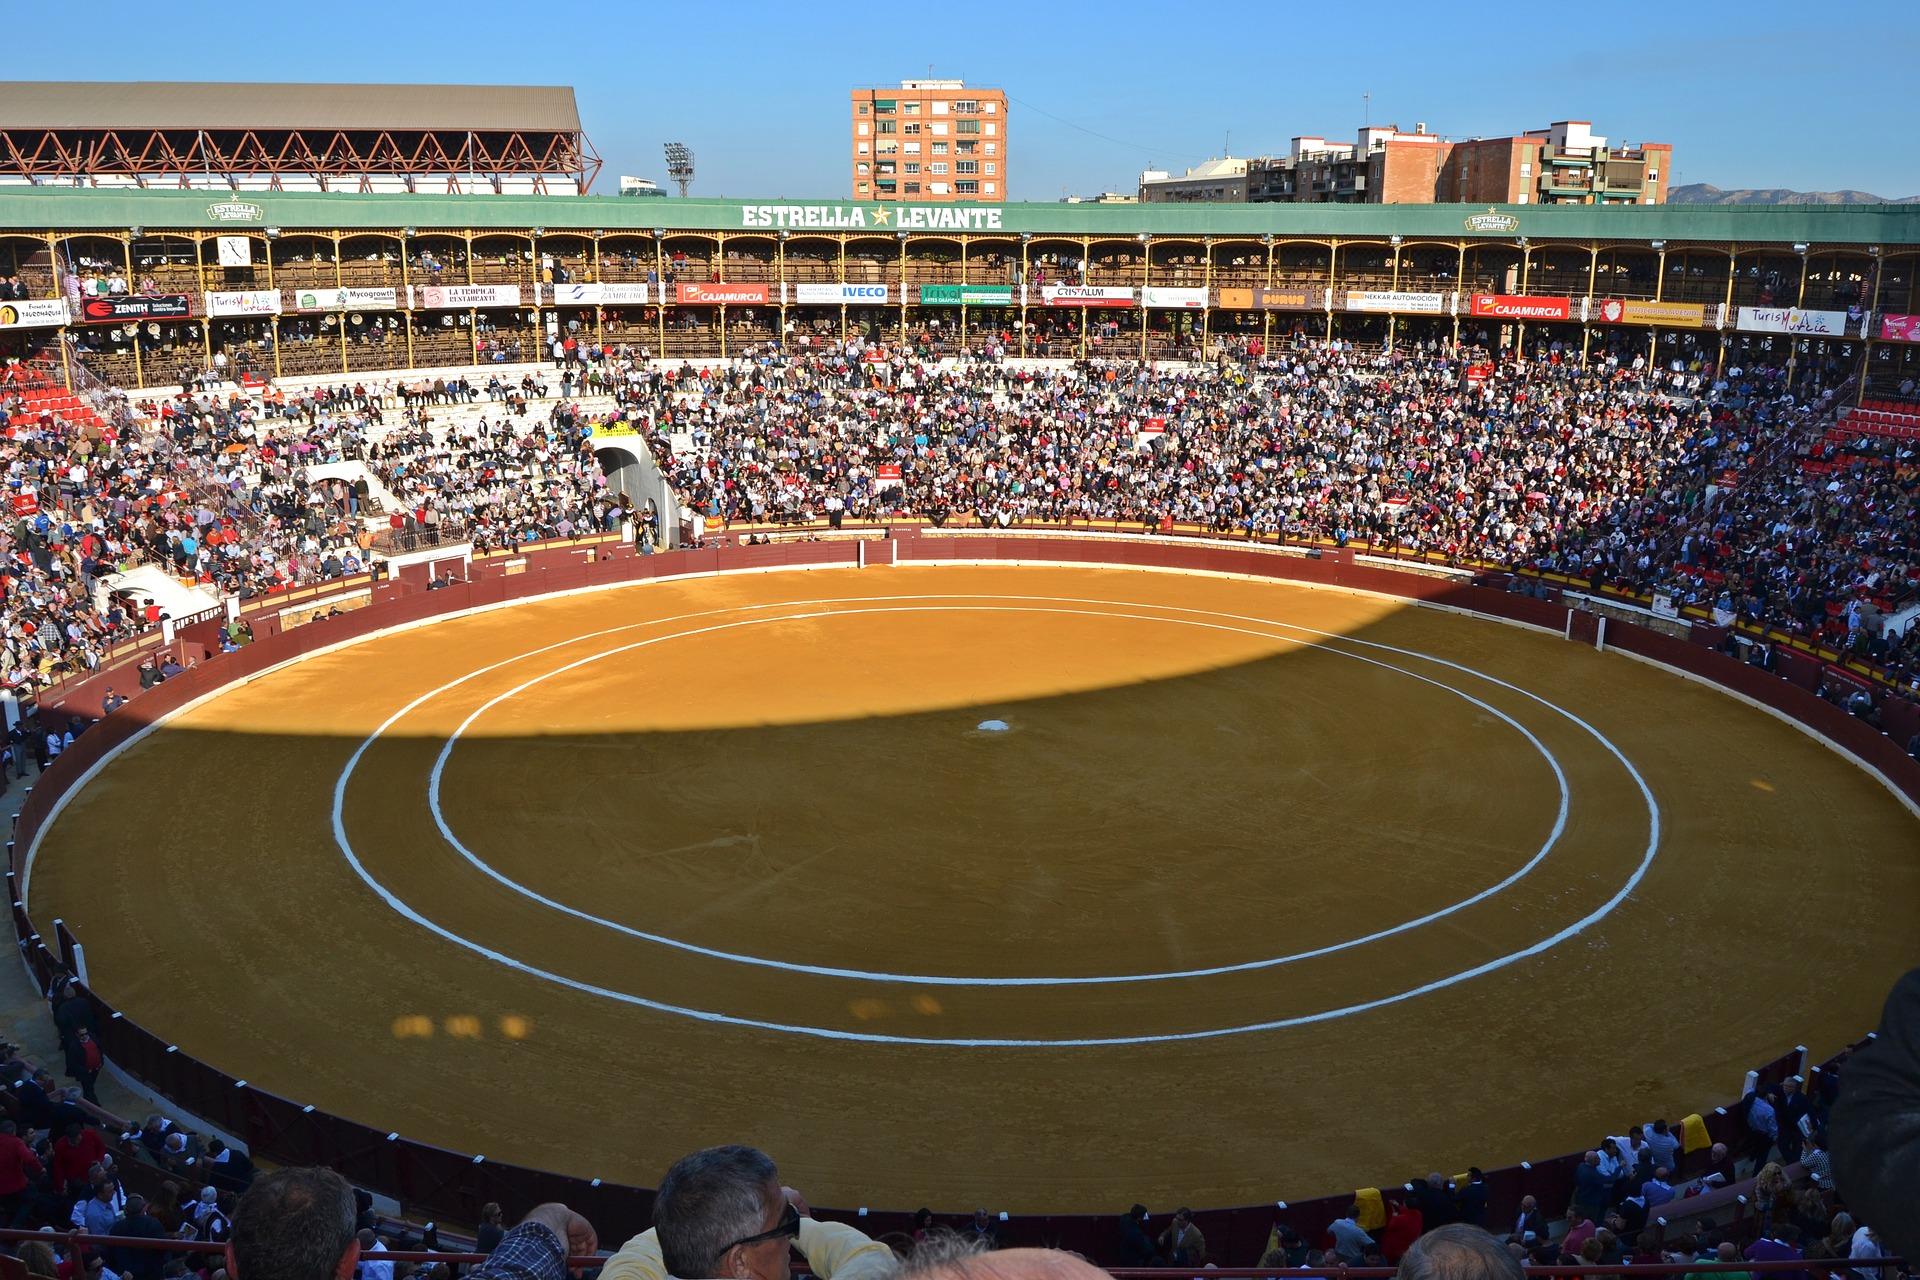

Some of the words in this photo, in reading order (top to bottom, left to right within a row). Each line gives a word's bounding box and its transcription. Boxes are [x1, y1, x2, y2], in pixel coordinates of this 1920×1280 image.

[213, 204, 256, 214] ESTRELLA
[742, 205, 866, 228] ESTRELLA
[896, 207, 1002, 229] LEVANTE
[1471, 216, 1512, 225] ESTRELLA
[349, 290, 395, 299] Mycogrowth
[461, 287, 497, 295] TROPICAL
[842, 287, 886, 297] IVECO
[1057, 288, 1105, 297] CRISTALUM
[700, 293, 763, 302] CAJAMURCIA
[1262, 294, 1306, 305] DURUS
[1392, 294, 1438, 302] AUTOMOCIÓN
[114, 303, 149, 314] ZENITH
[1495, 306, 1563, 317] CAJAMURCIA
